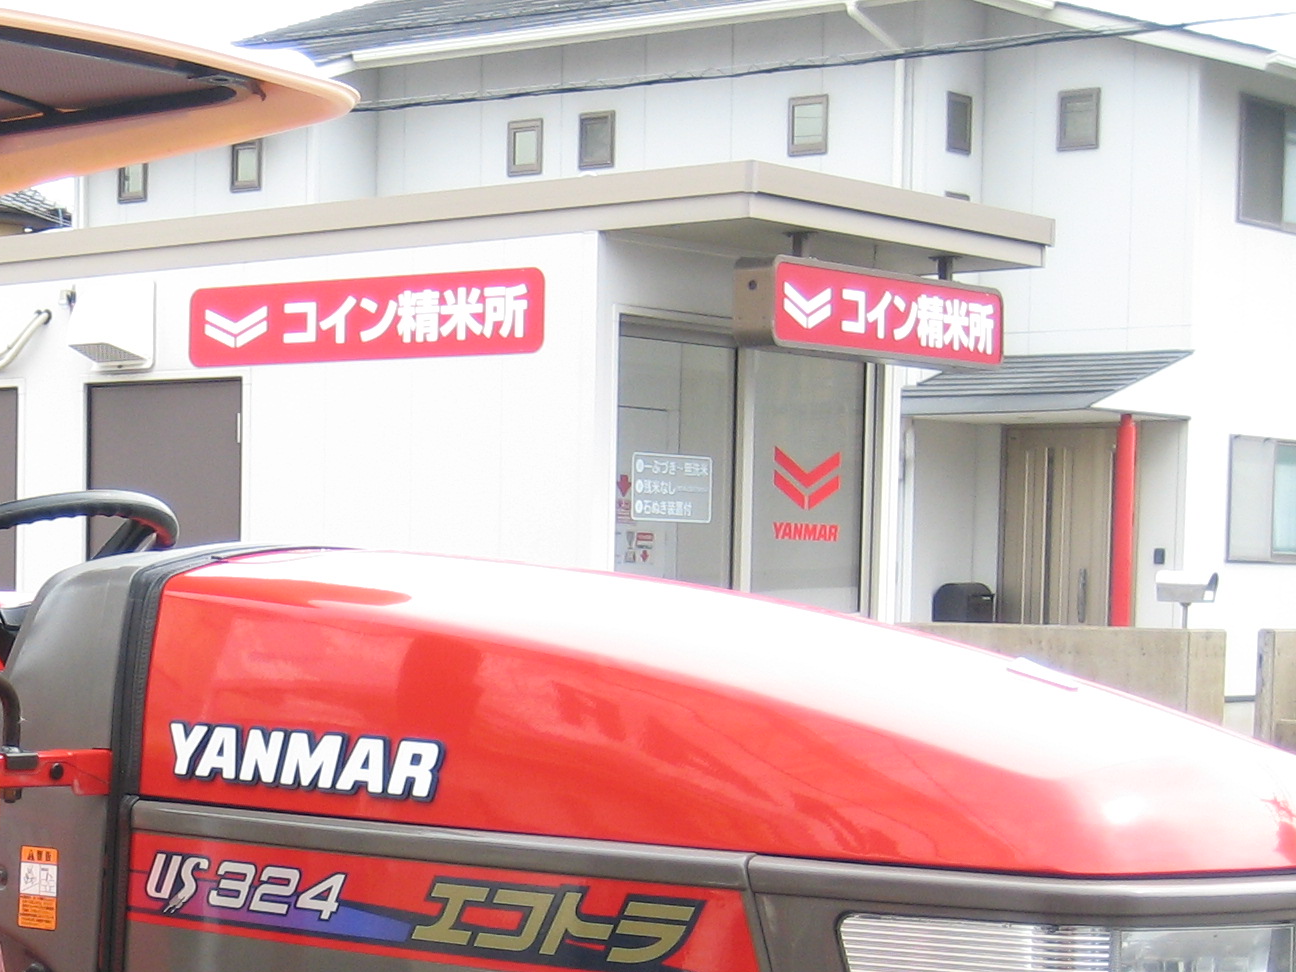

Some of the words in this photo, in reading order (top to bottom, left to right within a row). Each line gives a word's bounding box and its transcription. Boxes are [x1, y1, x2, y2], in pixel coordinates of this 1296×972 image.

[282, 283, 528, 344] コイン精米所
[840, 288, 995, 355] コイン精米所
[772, 521, 839, 542] YANMAR
[169, 721, 442, 800] YANMAR
[411, 882, 694, 964] エコトラ
